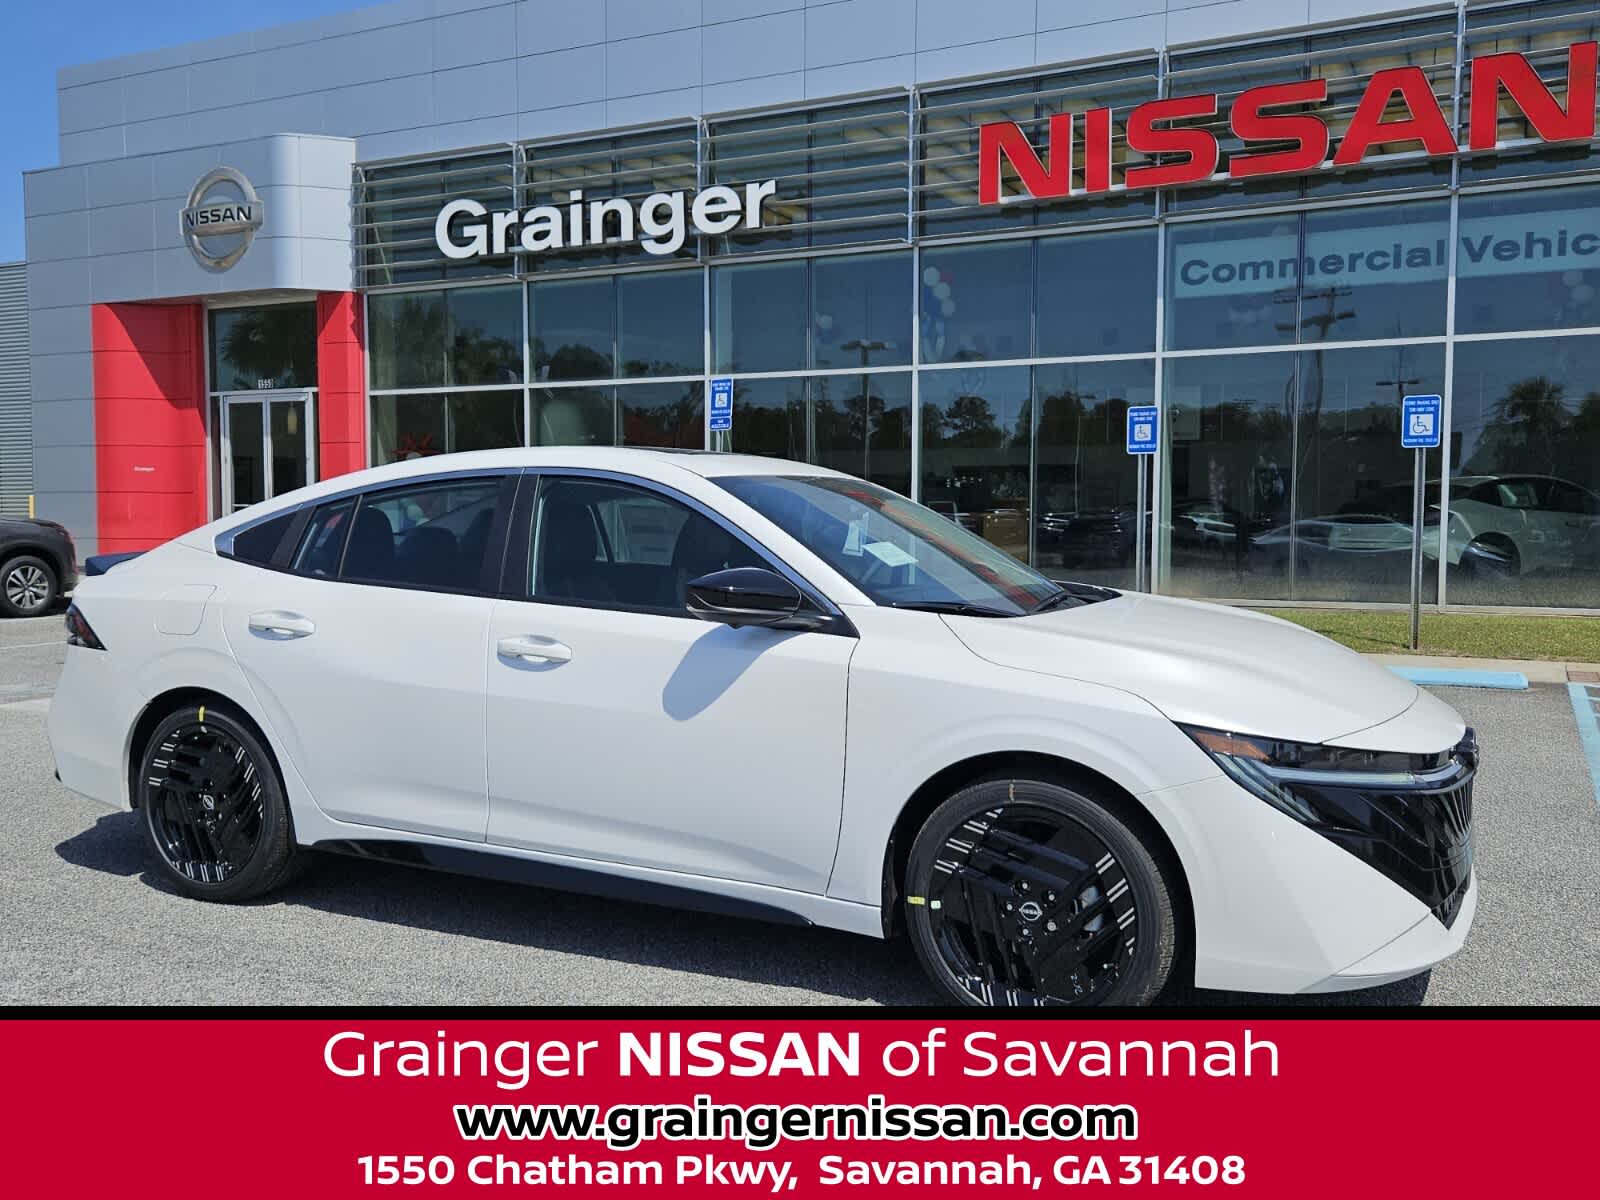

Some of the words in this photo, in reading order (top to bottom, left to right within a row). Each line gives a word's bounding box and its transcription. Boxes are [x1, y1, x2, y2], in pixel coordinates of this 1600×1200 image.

[979, 41, 1598, 204] NISSAN
[186, 206, 251, 226] NISSAN
[434, 178, 777, 259] Grainger
[1180, 239, 1446, 287] Commercial
[1461, 229, 1600, 264] Vehic
